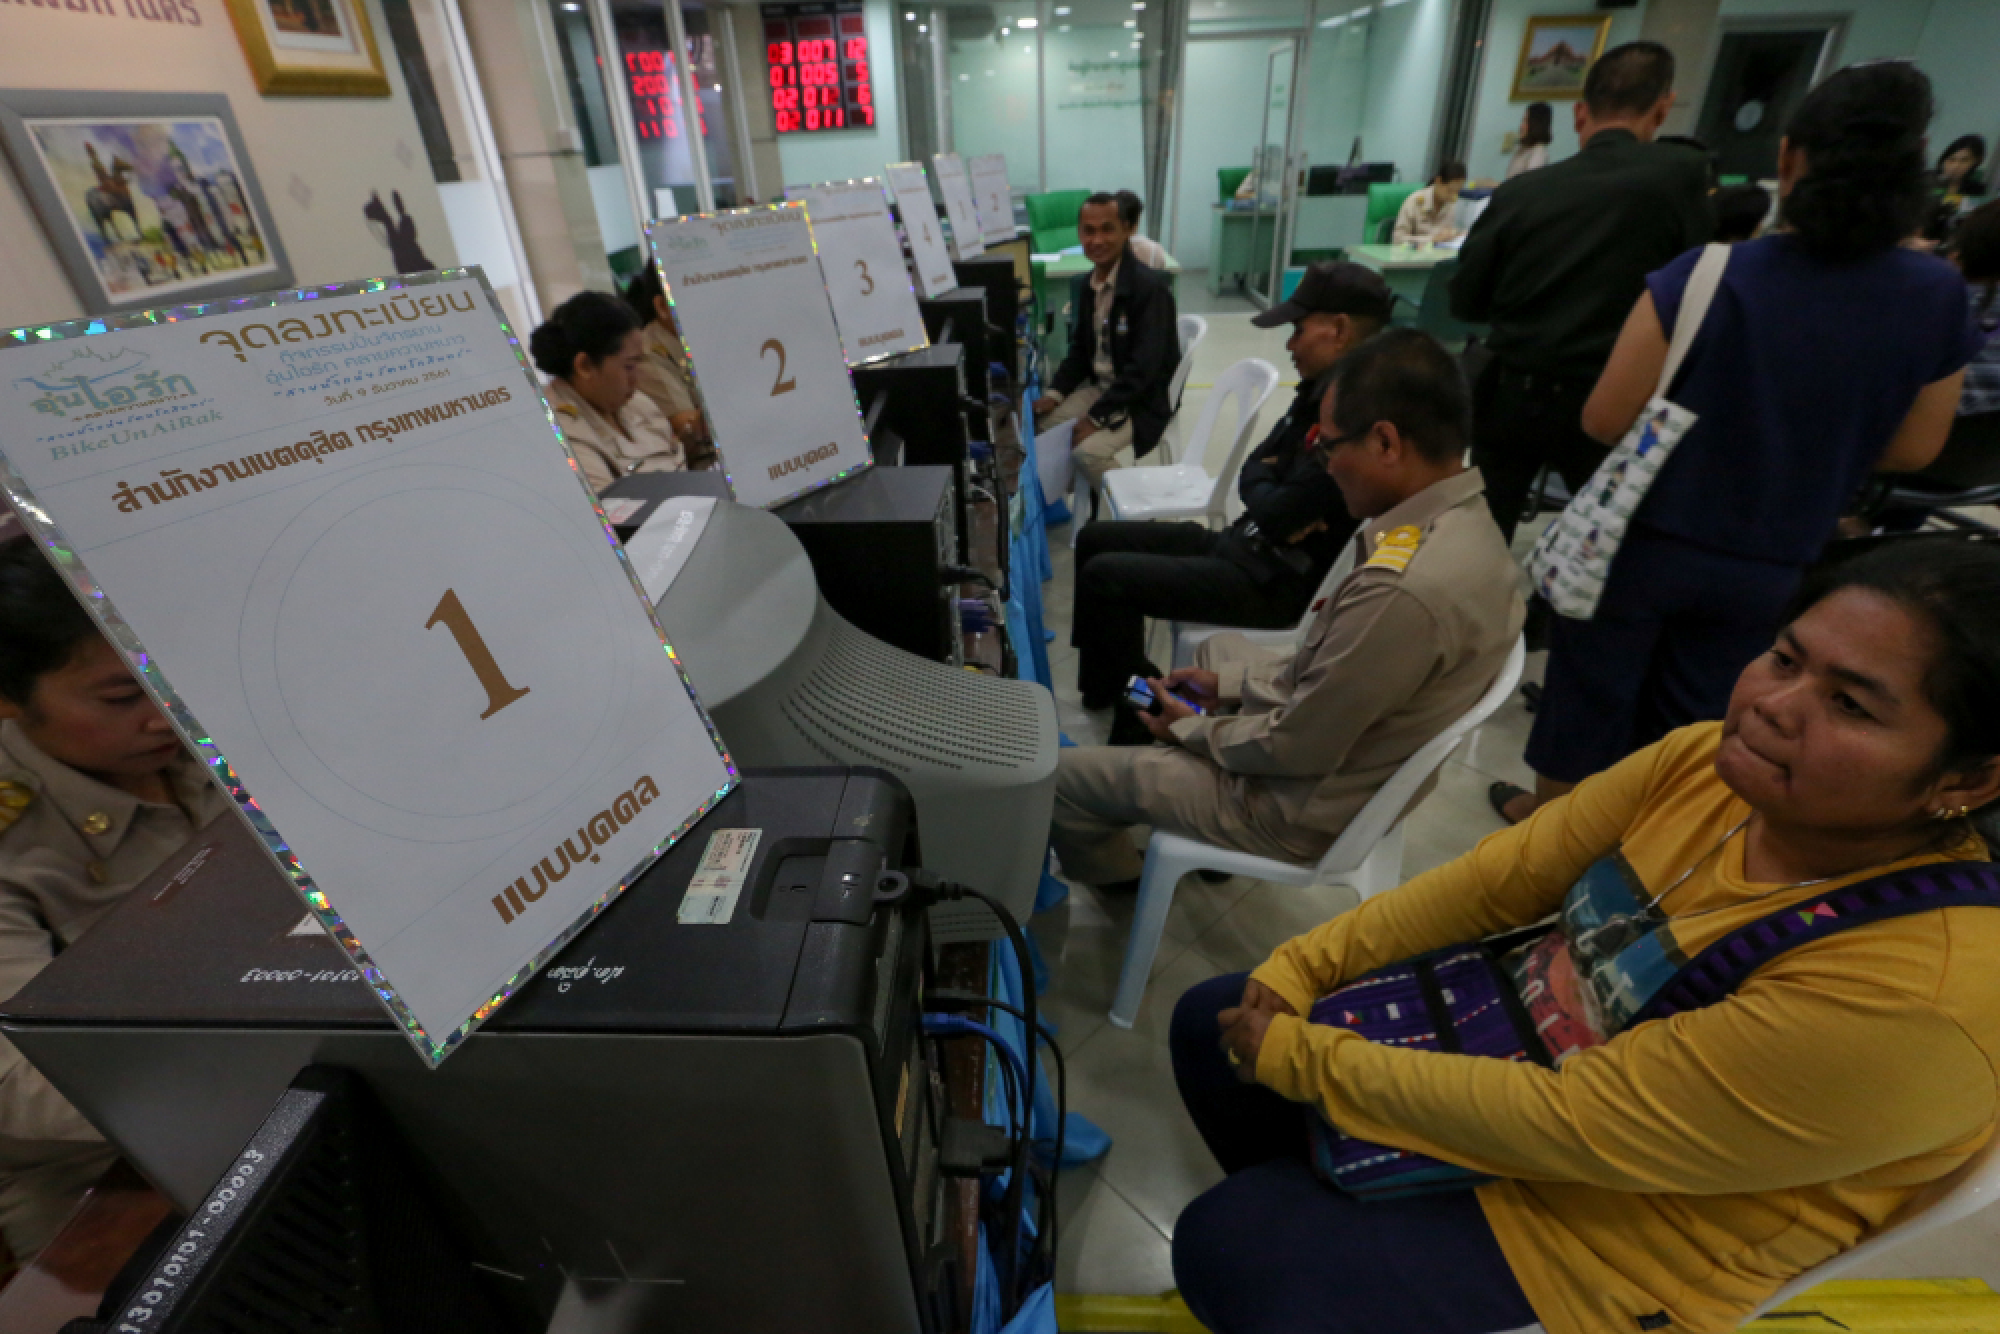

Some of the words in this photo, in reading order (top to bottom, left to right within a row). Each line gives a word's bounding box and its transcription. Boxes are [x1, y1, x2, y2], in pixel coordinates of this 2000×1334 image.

[767, 42, 793, 64] 03
[798, 38, 836, 62] 007
[769, 66, 796, 88] 01
[801, 62, 838, 85] 005
[856, 62, 869, 83] 5
[773, 88, 799, 110] 02
[858, 84, 871, 105] 6
[776, 110, 801, 132] 02
[805, 108, 844, 130] 011
[861, 106, 874, 126] 7
[854, 259, 875, 296] 3
[200, 291, 476, 362] จุดลงทะเบียน
[760, 338, 796, 396] 2
[111, 429, 355, 513] สำนักงานเขตดุสิต
[356, 385, 512, 443] กรุงเทพมหานคร
[768, 442, 838, 480] แบบบุคคล
[424, 588, 531, 720] 1
[492, 774, 660, 925] แบบบุคคล
